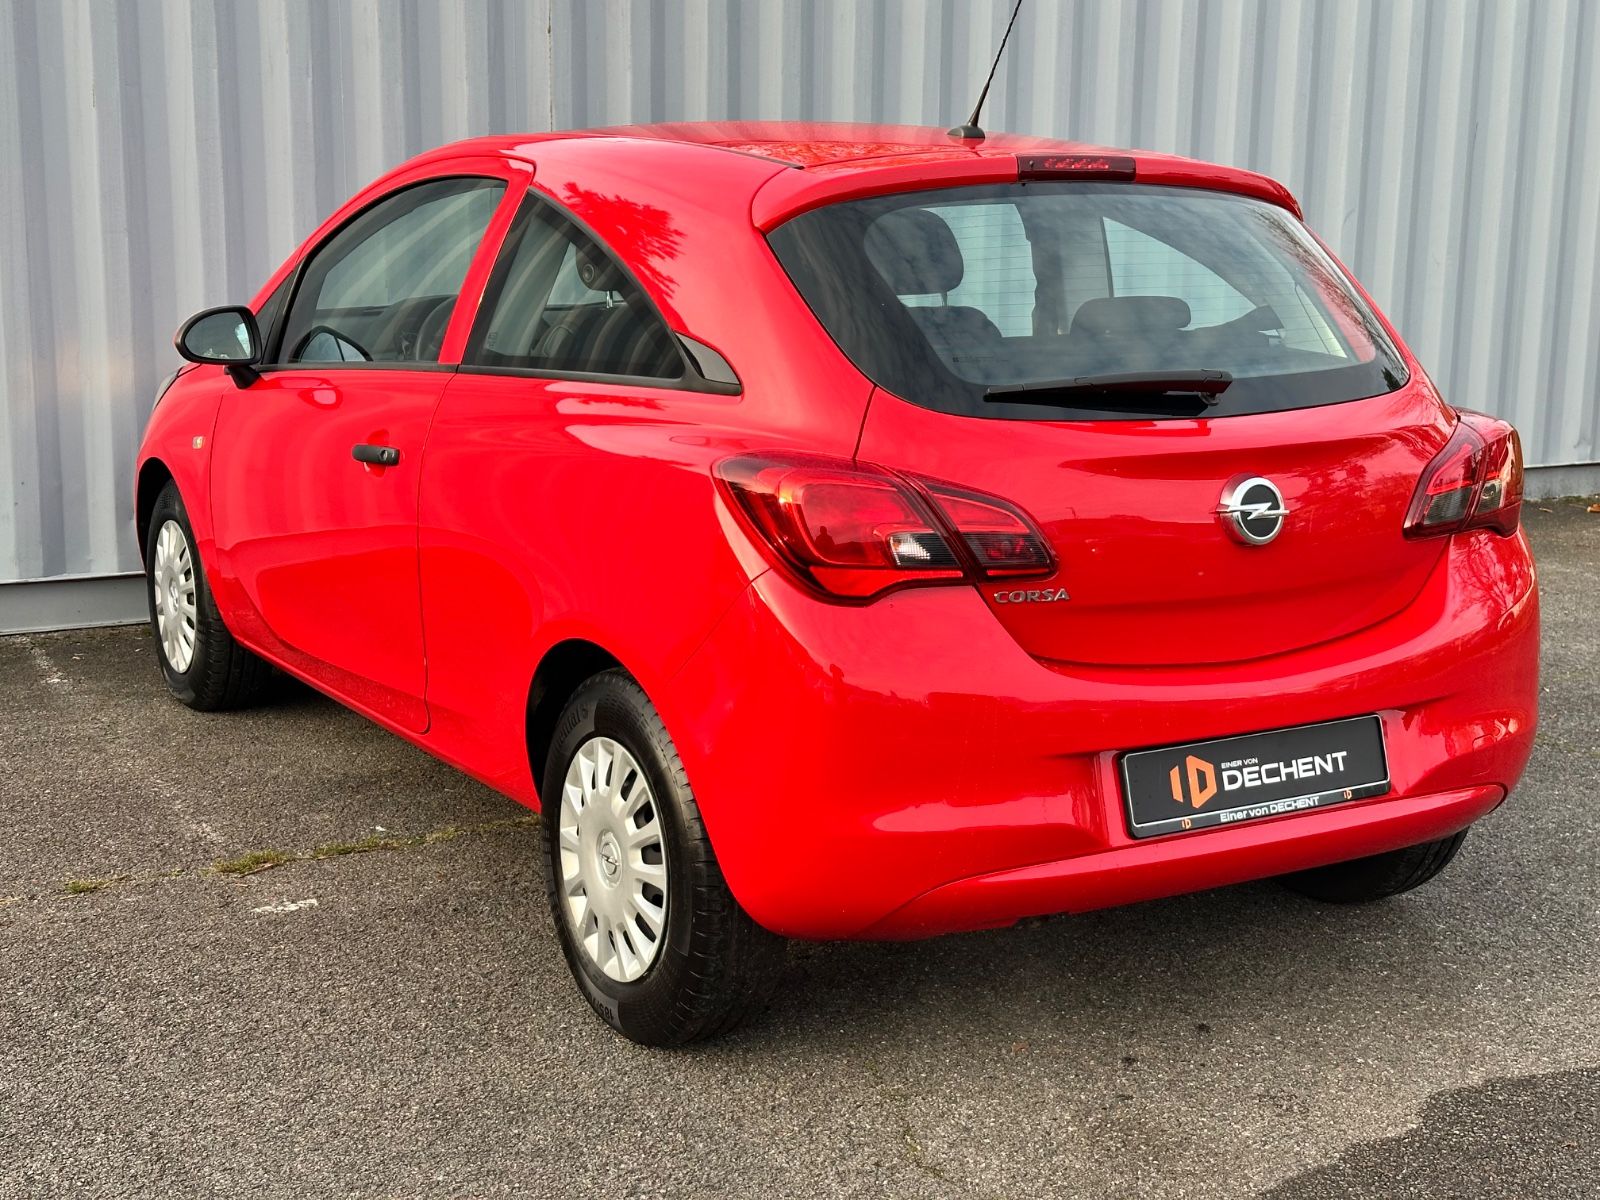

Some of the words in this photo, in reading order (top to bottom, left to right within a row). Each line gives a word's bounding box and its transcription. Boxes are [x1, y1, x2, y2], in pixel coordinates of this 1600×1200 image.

[993, 587, 1070, 604] CORSA
[1221, 760, 1243, 769] EINER
[1243, 757, 1259, 766] VON
[1222, 751, 1347, 791] DECHENT
[1220, 810, 1247, 823] Einer
[1248, 806, 1269, 817] von
[1269, 796, 1319, 814] DECHENT
